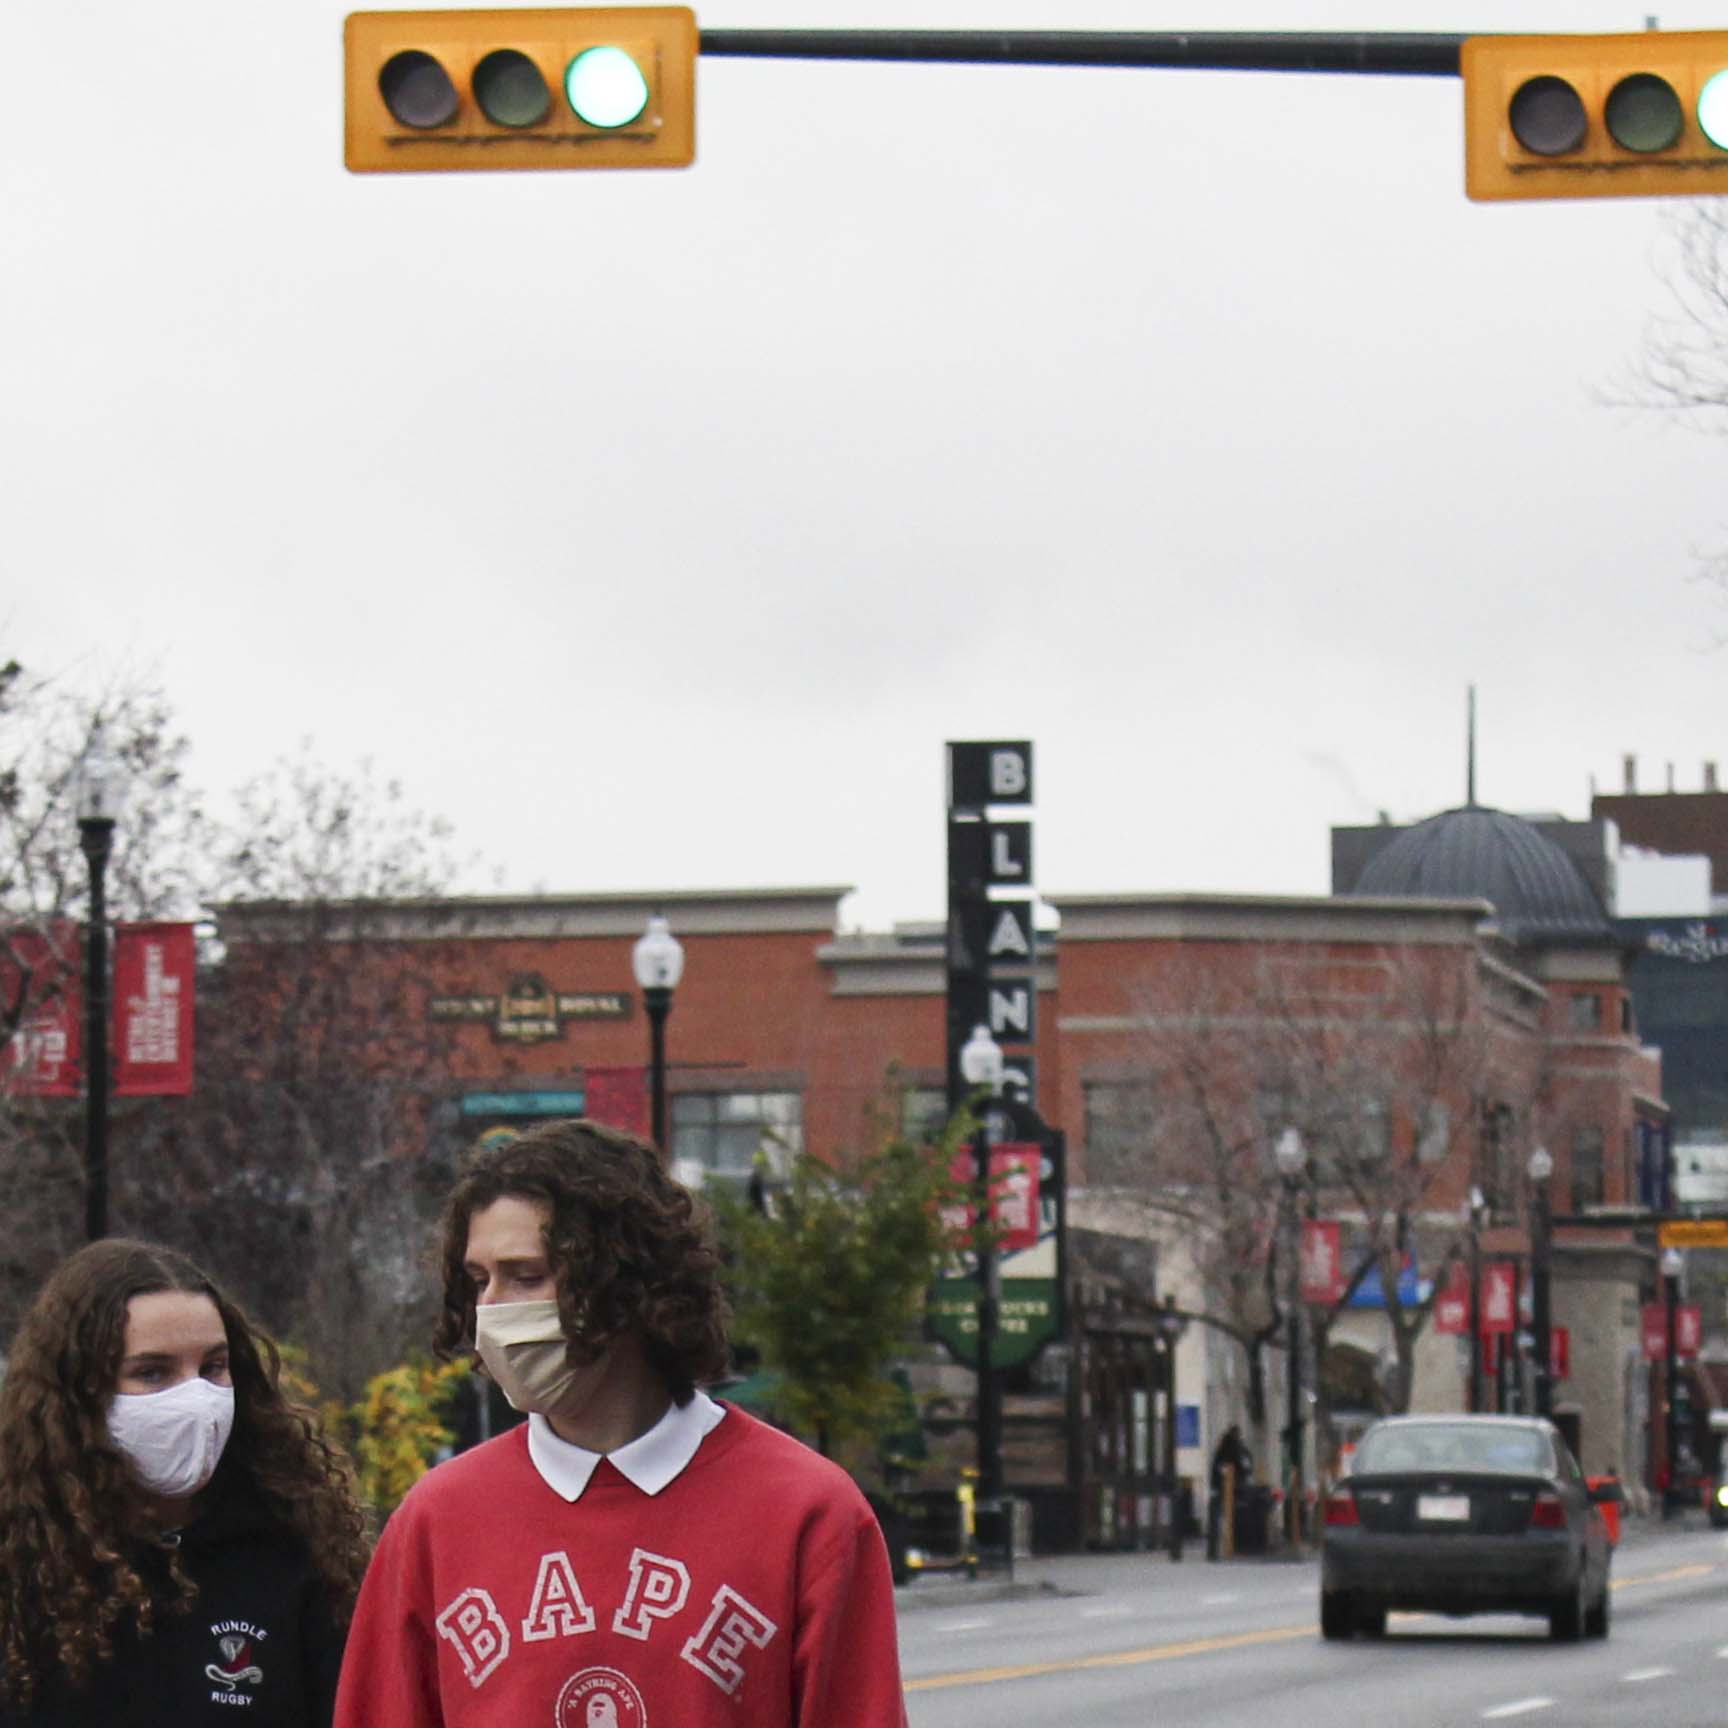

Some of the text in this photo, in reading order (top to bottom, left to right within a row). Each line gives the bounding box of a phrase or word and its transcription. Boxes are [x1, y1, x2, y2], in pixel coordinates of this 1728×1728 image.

[210, 1620, 269, 1640] RUNDLE
[435, 1547, 779, 1695] BAPE
[574, 1678, 618, 1697] BATHING
[211, 1691, 253, 1705] RUGBY
